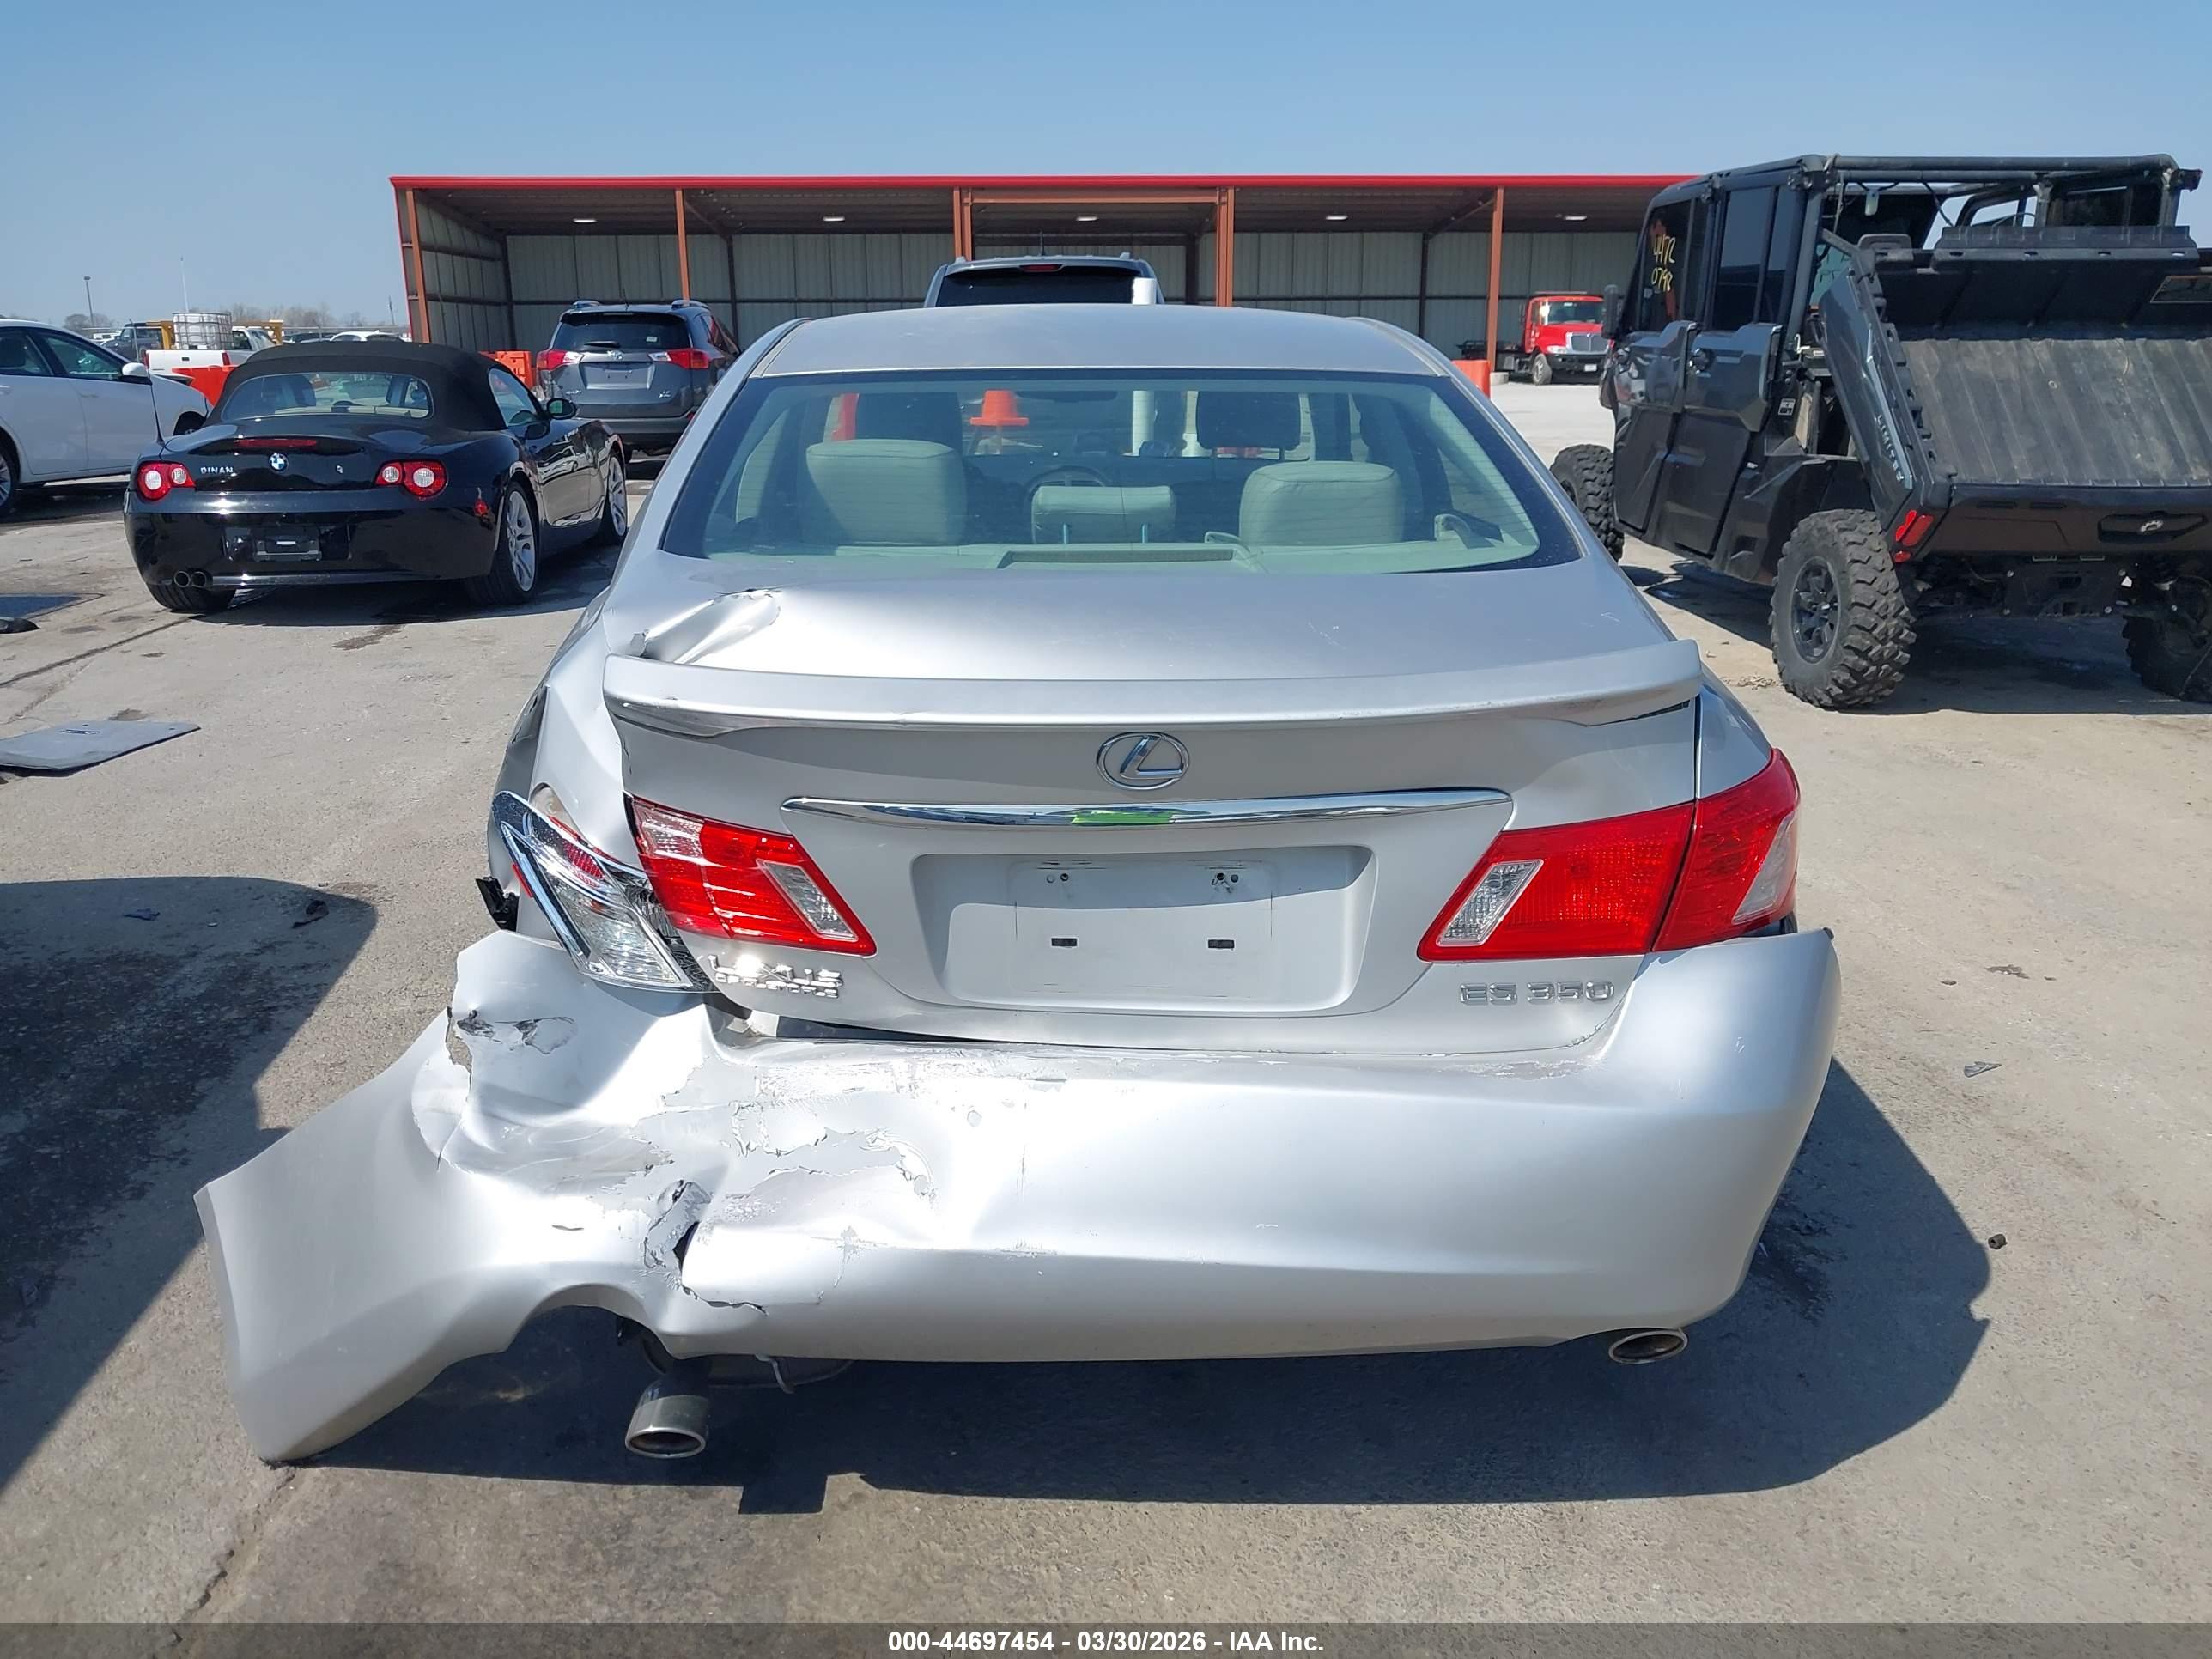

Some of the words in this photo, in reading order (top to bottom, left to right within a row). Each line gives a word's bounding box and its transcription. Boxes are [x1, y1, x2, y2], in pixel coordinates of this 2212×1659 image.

[708, 954, 843, 988] LXUS
[1460, 982, 1517, 1005] ES
[1527, 981, 1615, 1004] 350
